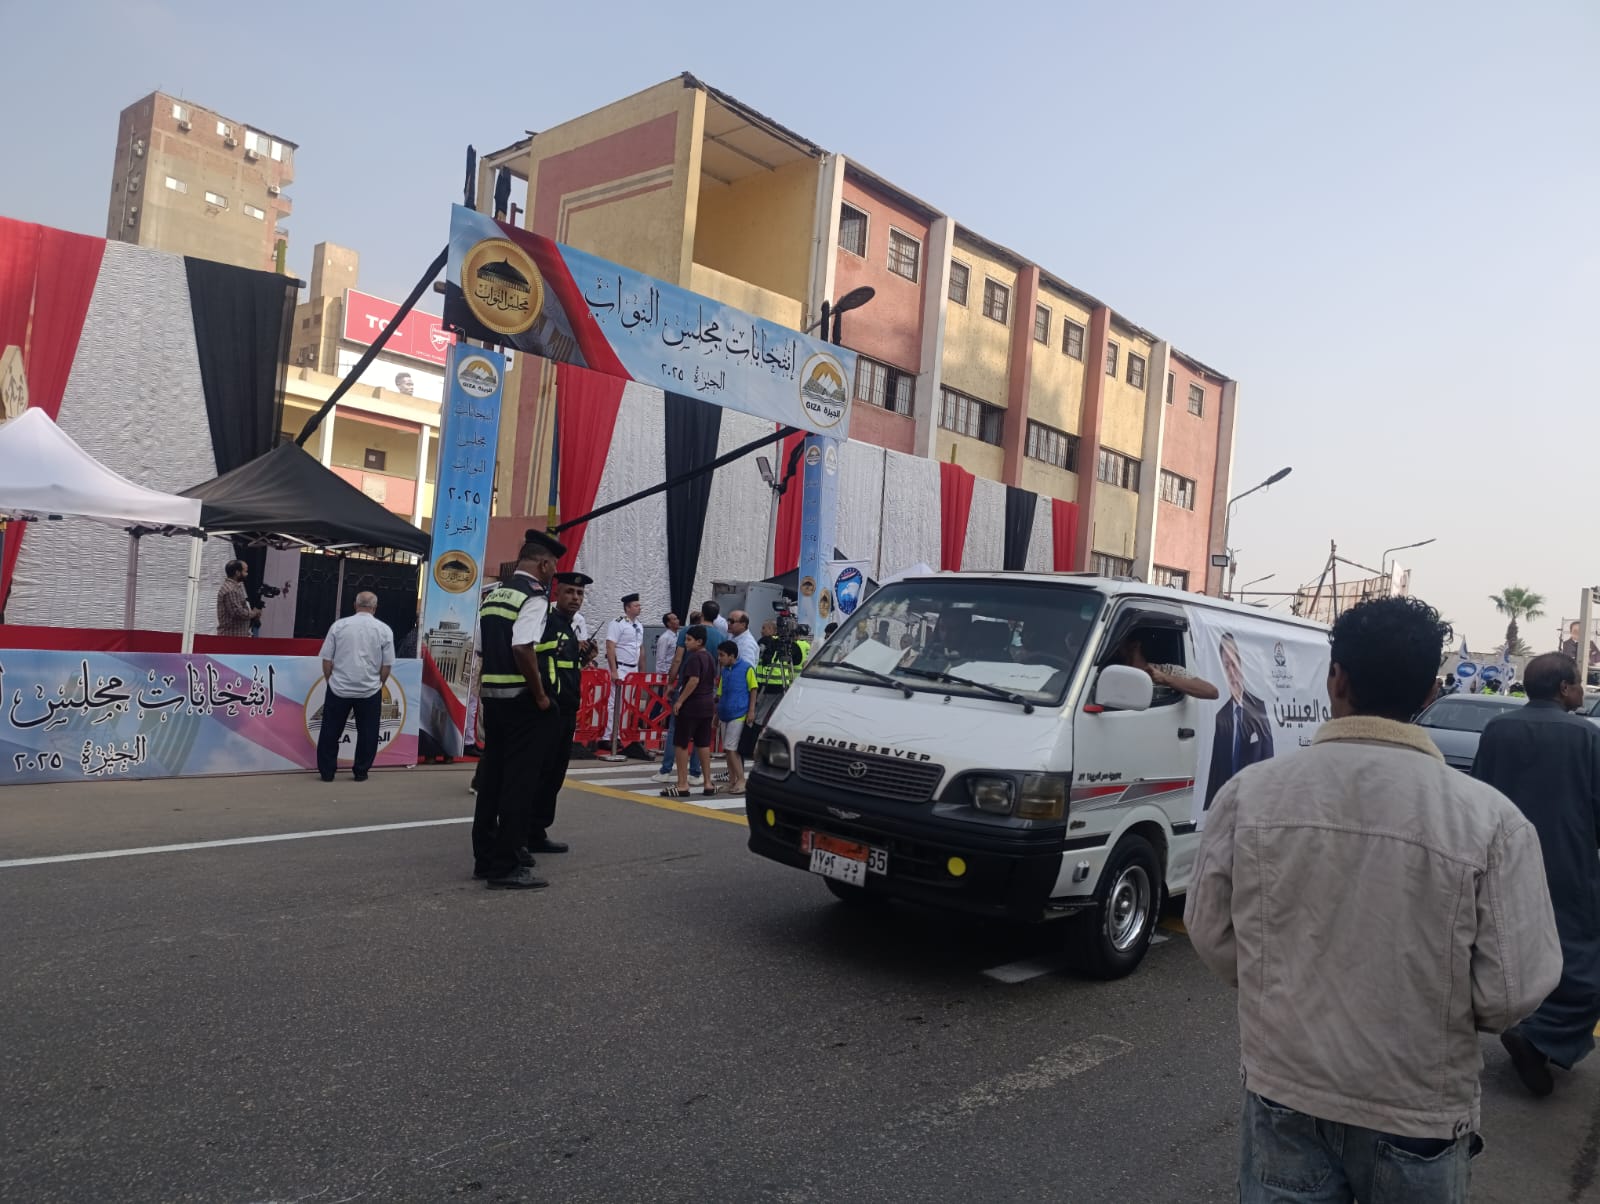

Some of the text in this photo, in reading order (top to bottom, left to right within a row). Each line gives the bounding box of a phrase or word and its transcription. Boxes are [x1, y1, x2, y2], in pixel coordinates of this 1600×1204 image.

[584, 276, 660, 333] النواب
[661, 304, 722, 355] مجلس
[661, 363, 726, 394] الجيزة ٢٠٢٥
[805, 401, 821, 412] GIZA
[823, 407, 840, 419] الجيزة
[448, 487, 480, 504] ٢٠٢٥
[9, 659, 131, 731] مجلس
[137, 662, 275, 721] إنتخابات
[1274, 697, 1320, 728] العينين
[14, 735, 148, 776] الجيزة ٢٠٢٥
[805, 735, 858, 751] RANGE
[869, 850, 887, 872] 55
